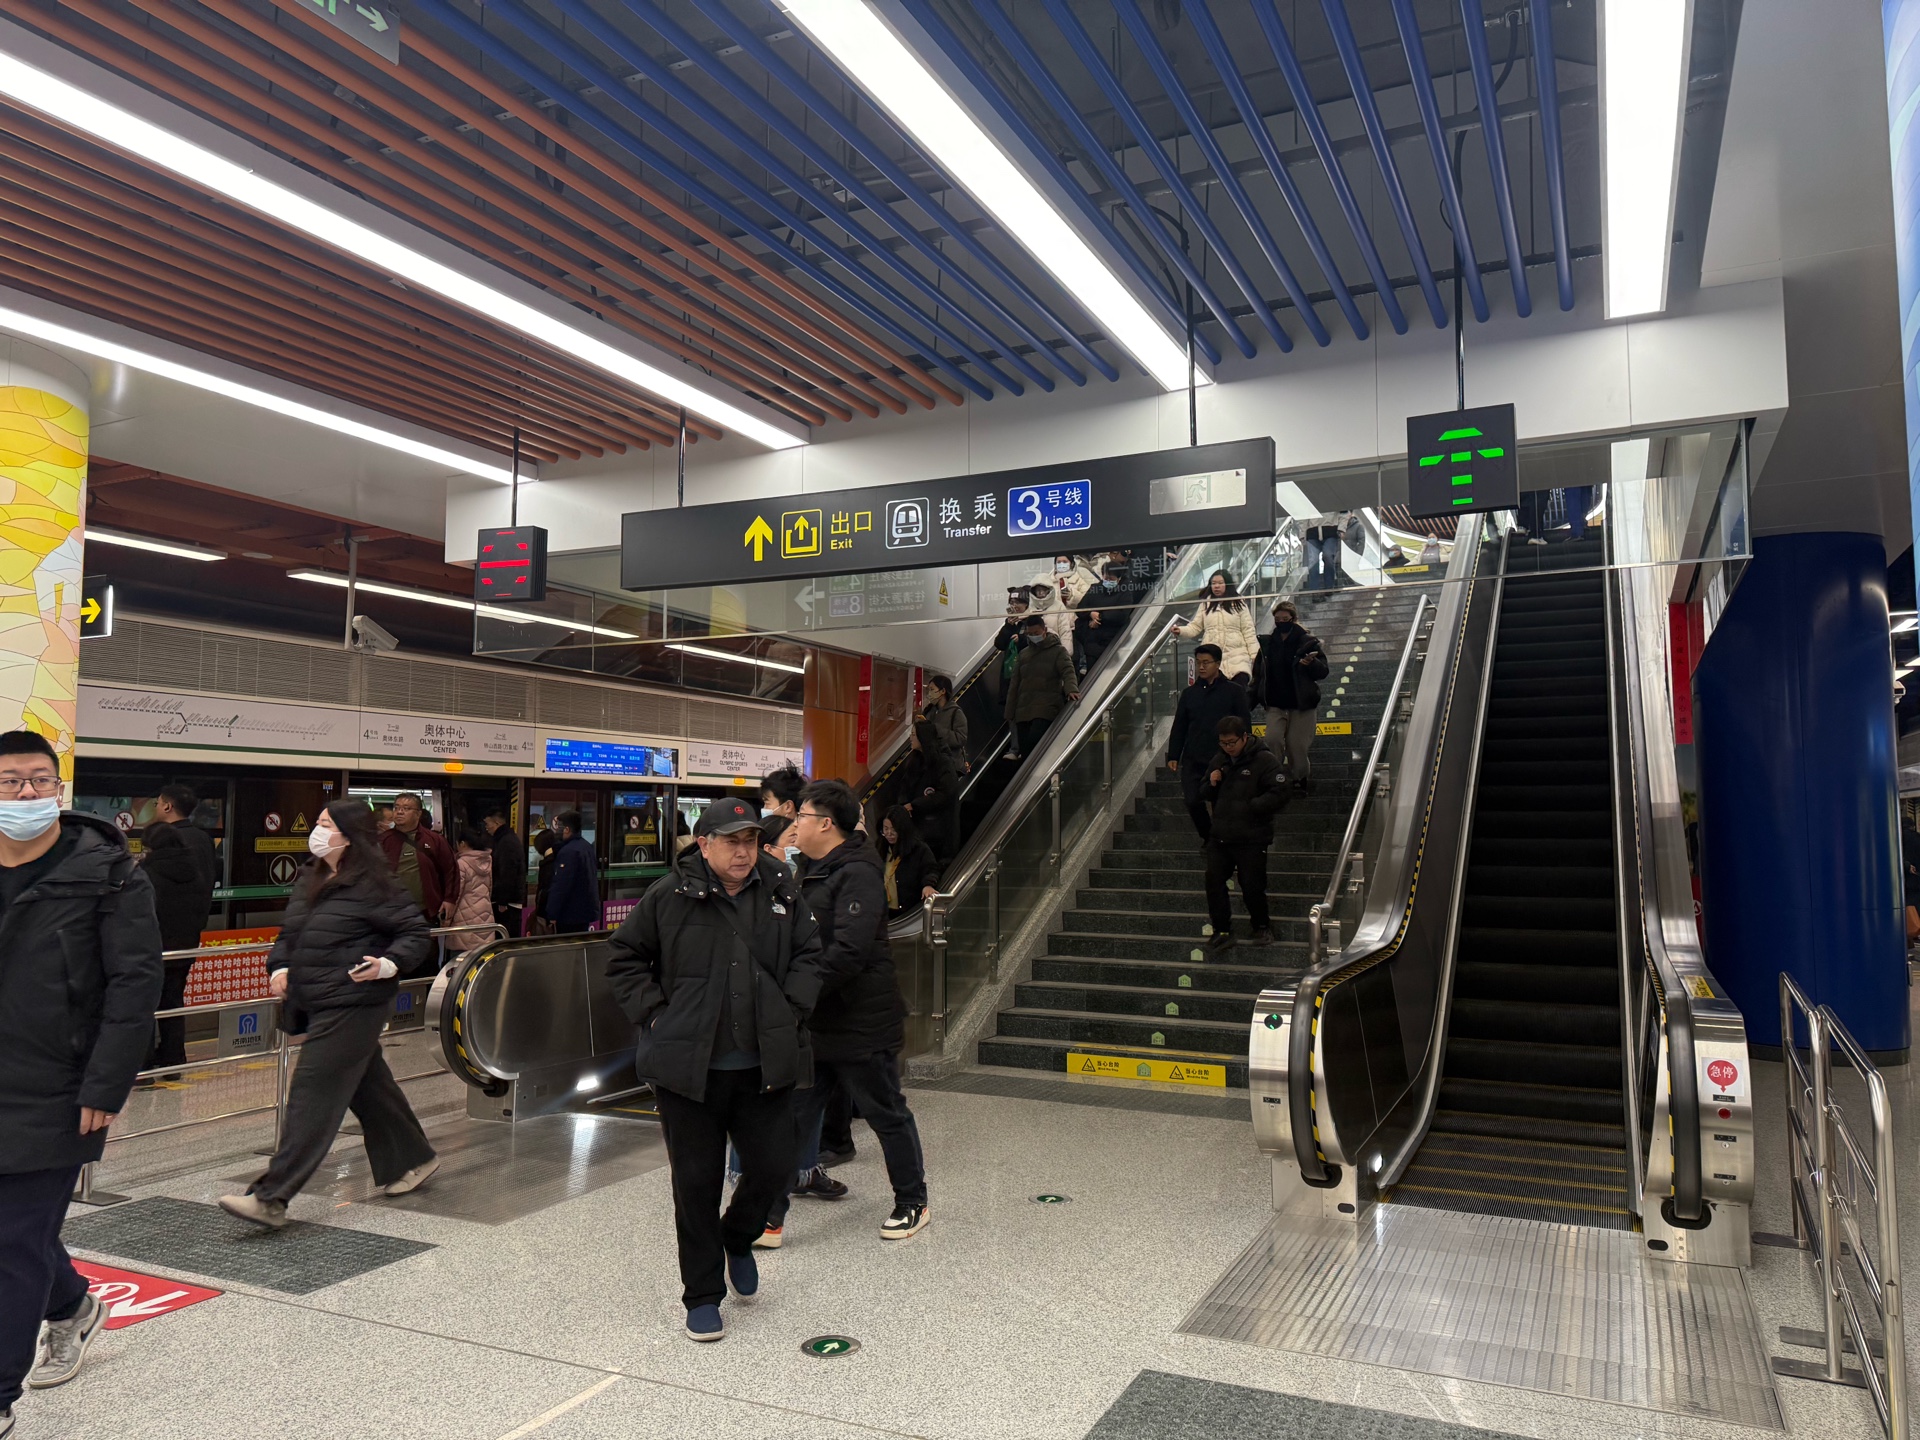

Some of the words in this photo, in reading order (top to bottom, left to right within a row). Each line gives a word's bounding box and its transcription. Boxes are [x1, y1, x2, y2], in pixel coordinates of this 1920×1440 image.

[939, 493, 997, 524] 换乘
[1017, 490, 1042, 531] 3
[1045, 487, 1083, 508] 号线
[831, 511, 872, 534] 出口
[1045, 515, 1072, 528] Line
[1074, 513, 1083, 525] 3
[943, 524, 992, 538] Transfer
[830, 538, 853, 550] Exit
[424, 724, 466, 739] 奥体中心
[419, 738, 446, 747] OLYMPIC
[446, 740, 470, 748] SPORTS
[433, 746, 457, 754] CENTER
[1186, 1068, 1209, 1076] 当心台阶
[1710, 1065, 1734, 1079] 急停
